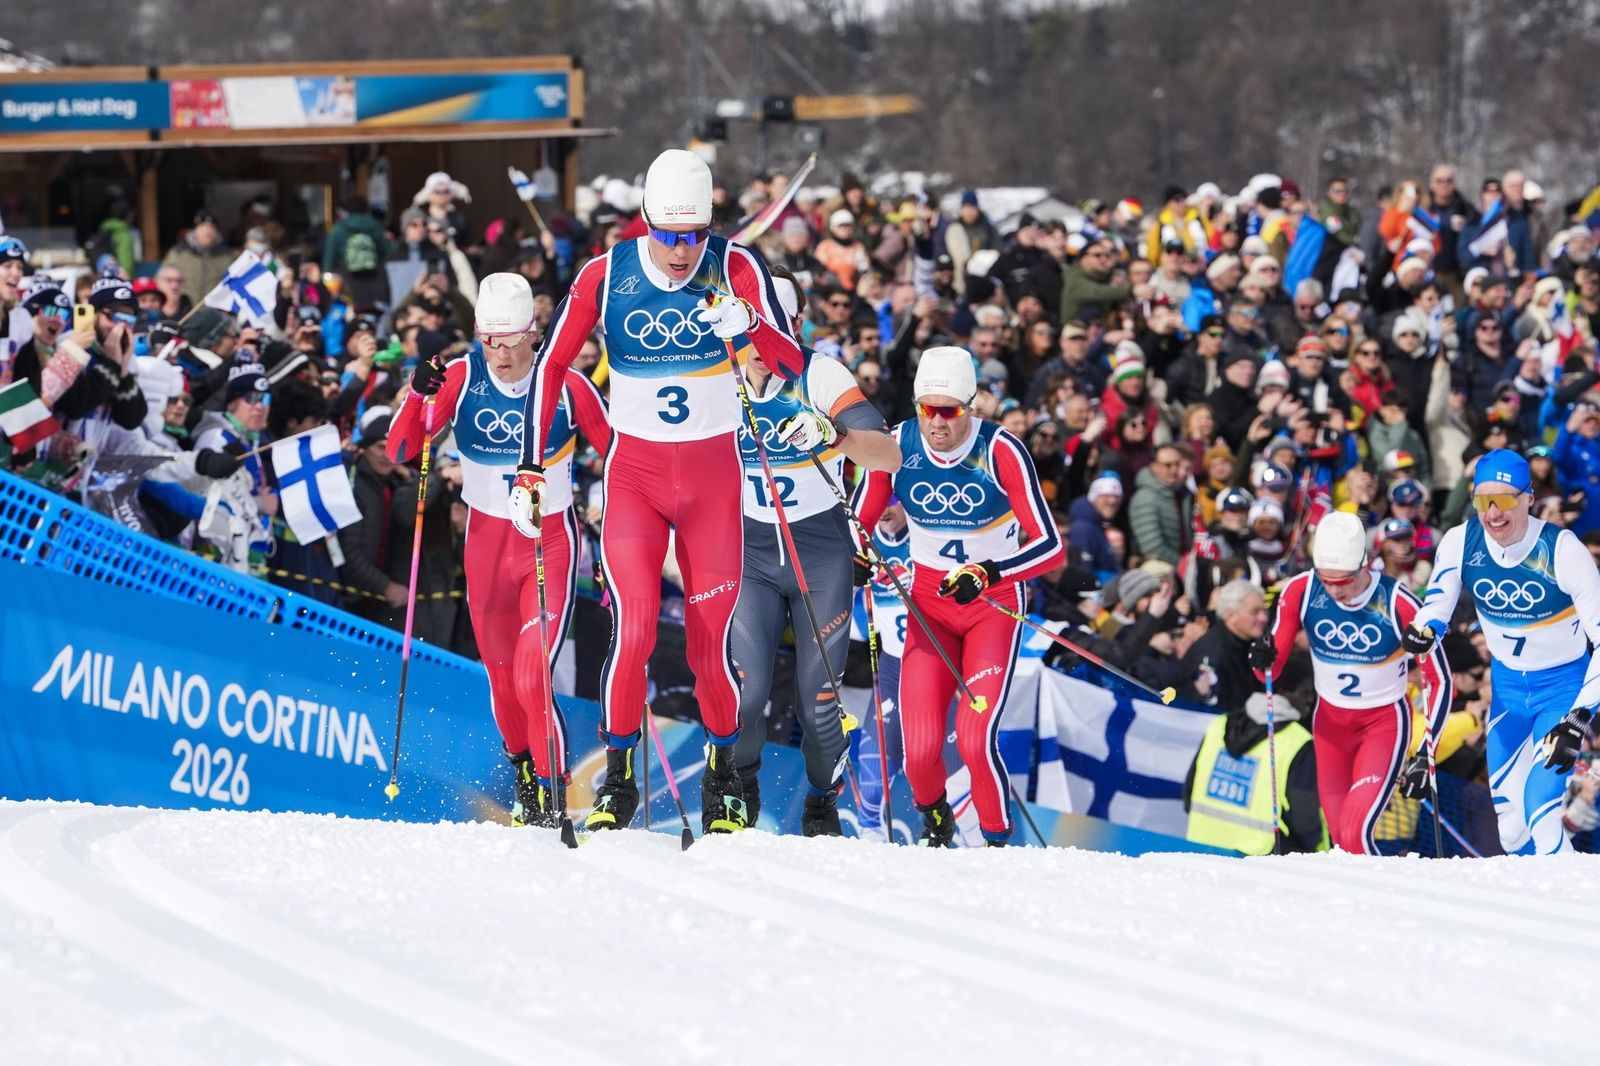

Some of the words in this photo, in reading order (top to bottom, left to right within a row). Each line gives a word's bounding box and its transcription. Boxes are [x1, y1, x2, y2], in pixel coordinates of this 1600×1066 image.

[2, 99, 55, 122] Burger
[56, 98, 70, 117] &
[72, 98, 101, 116] Hot
[102, 96, 137, 120] Dog
[624, 354, 661, 362] MILANO
[661, 354, 703, 362] CORTINA
[704, 349, 722, 359] 2026
[656, 385, 690, 425] 3
[471, 443, 503, 453] MILANO
[746, 474, 799, 508] 12
[939, 518, 976, 526] CORTINA
[977, 516, 994, 525] 2026
[1005, 523, 1016, 540] 4
[939, 539, 970, 564] 4
[689, 584, 725, 604] CRAFT
[1503, 612, 1536, 620] CORTINA
[1571, 618, 1580, 636] 7
[1502, 633, 1527, 657] 7
[965, 667, 994, 687] CRAFT
[1398, 661, 1406, 678] 2
[1338, 673, 1362, 697] 2
[32, 644, 211, 729] MILANO
[218, 683, 388, 772] CORTINA
[170, 738, 251, 806] 2026
